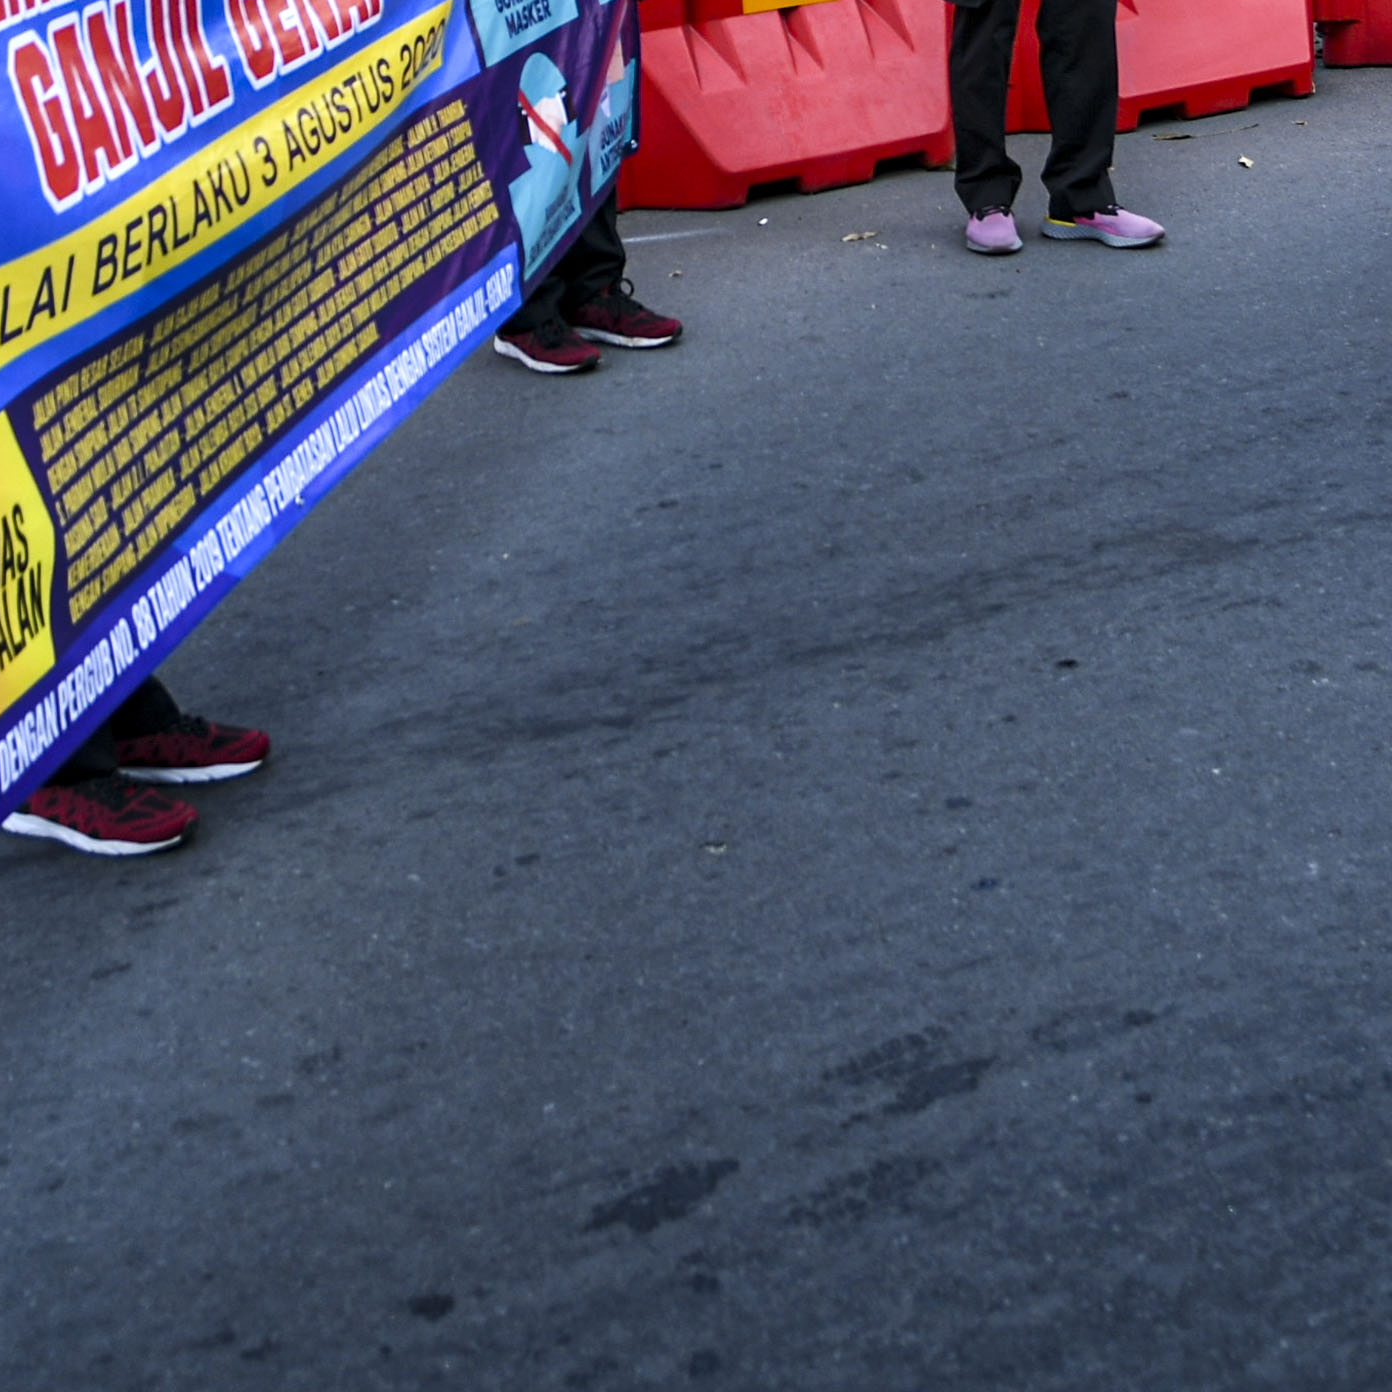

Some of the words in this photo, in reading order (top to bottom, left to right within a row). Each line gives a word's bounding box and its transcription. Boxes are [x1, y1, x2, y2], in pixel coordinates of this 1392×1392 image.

[92, 150, 251, 296] BERLAKU
[261, 136, 279, 186] 3
[281, 61, 394, 172] AGUSTUS
[58, 638, 114, 731] PERGUB
[110, 618, 139, 675] NO.
[147, 555, 196, 631] TAHUN
[189, 529, 225, 592] 2019
[216, 484, 272, 562] TENTANG
[330, 395, 360, 453] LALU
[353, 372, 392, 431] LINTAS
[384, 337, 429, 402] DENGAN
[422, 311, 458, 369] SISTEM
